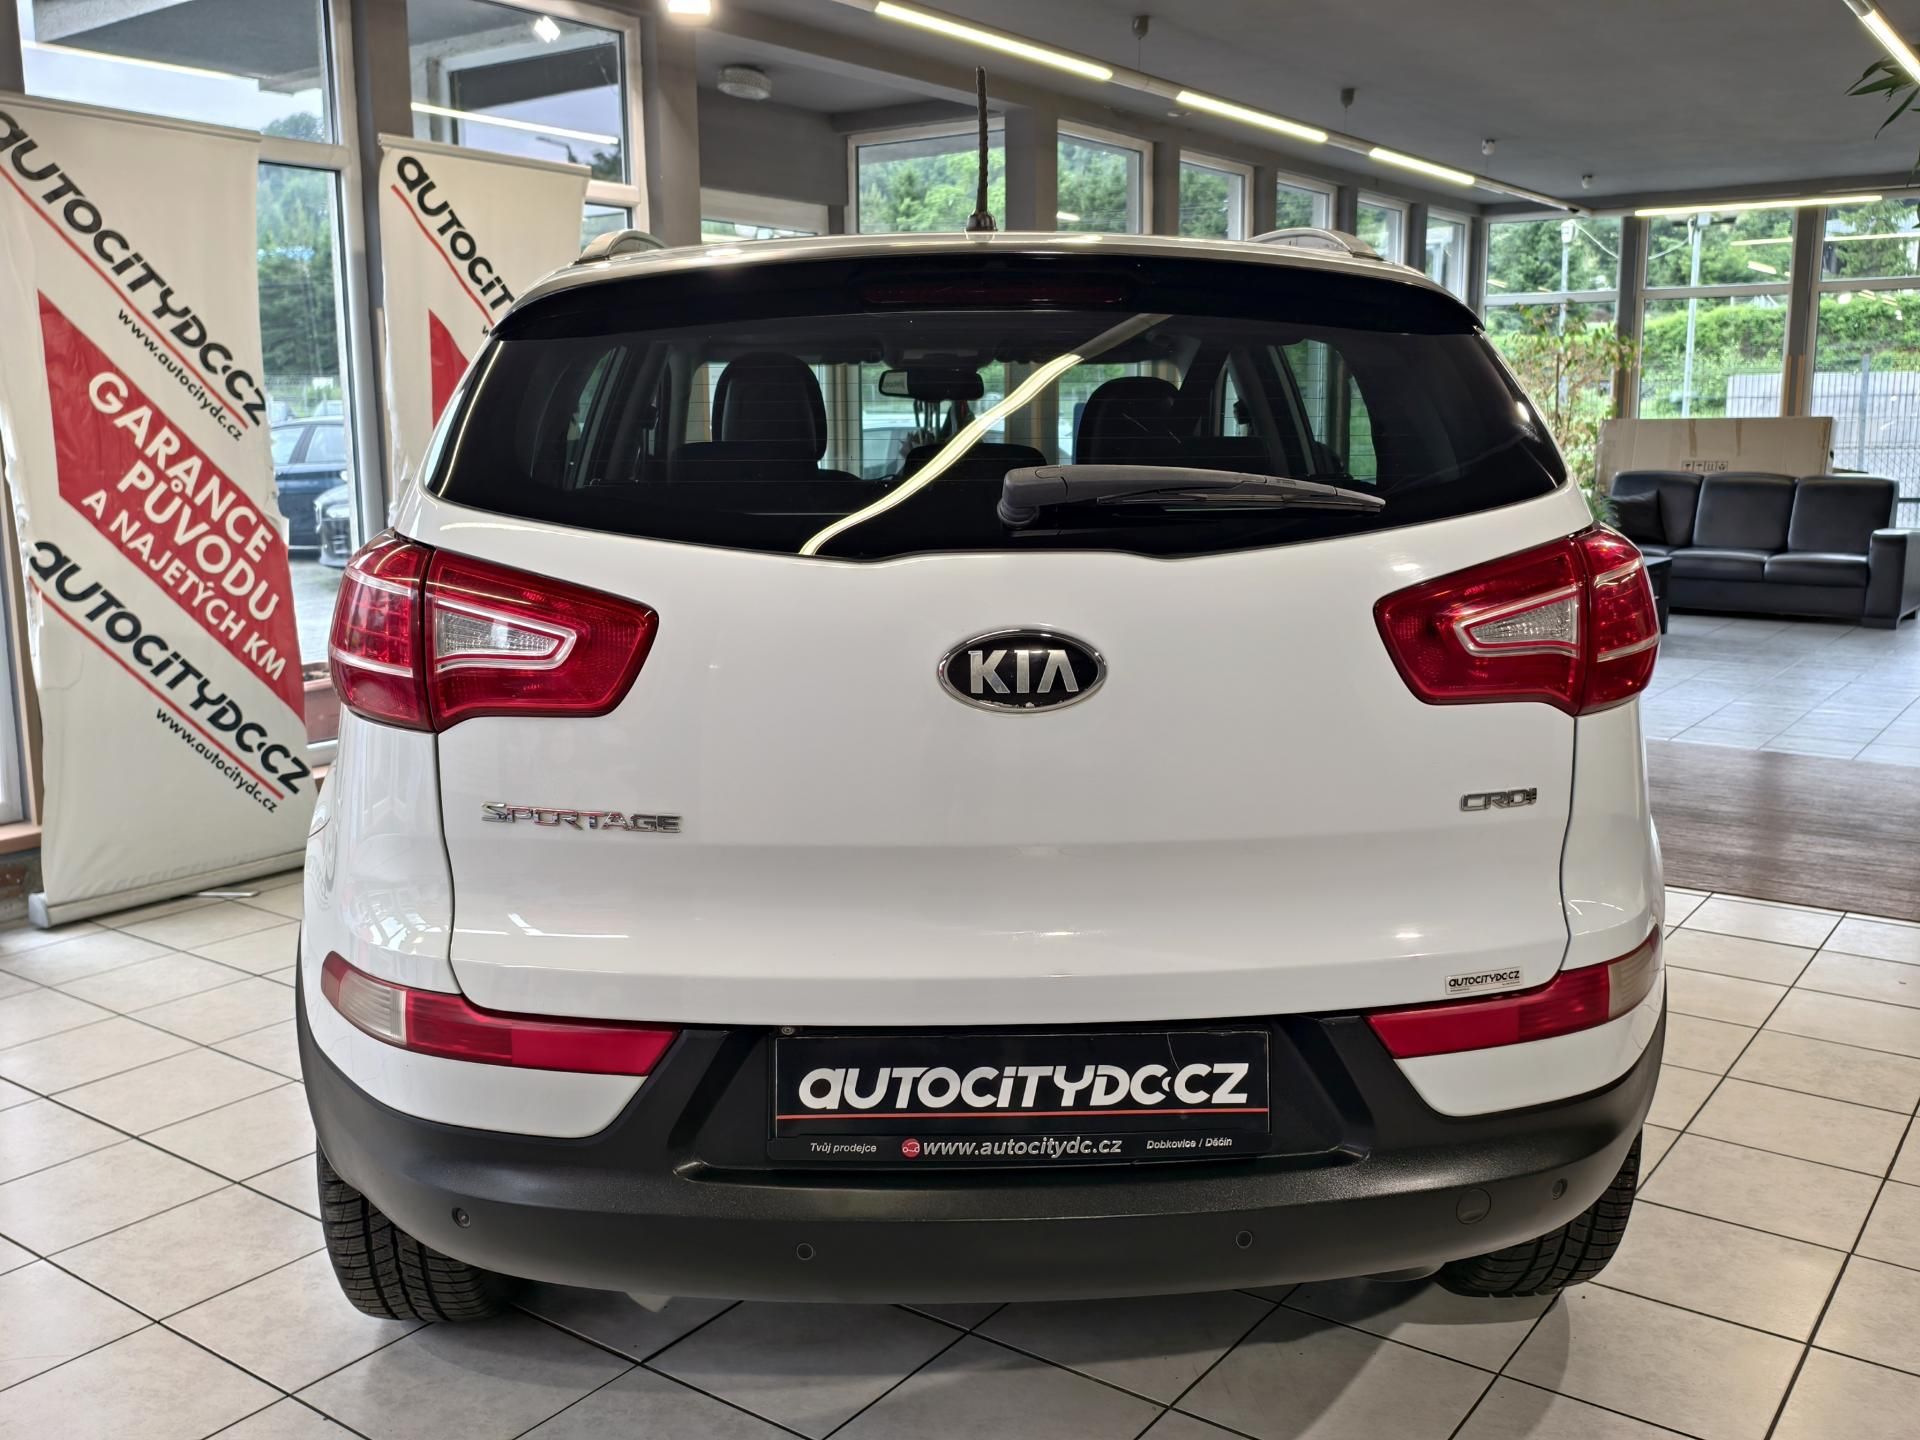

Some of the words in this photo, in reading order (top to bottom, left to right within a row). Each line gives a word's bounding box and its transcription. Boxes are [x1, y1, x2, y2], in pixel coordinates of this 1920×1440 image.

[117, 308, 243, 441] www.autocitydc.cz
[88, 371, 274, 562] GARANCE
[81, 489, 107, 520] A
[108, 509, 247, 641] NAJETÝCH
[242, 632, 287, 682] KM
[116, 460, 279, 621] PŮVODU
[967, 649, 1080, 694] KIA
[156, 708, 278, 813] www.autocitydc.cz
[481, 801, 682, 833] SPORTAGE
[810, 1142, 831, 1153] Tvůj
[833, 1143, 877, 1154] prodejce
[923, 1136, 1122, 1158] www.autocitydc.cz
